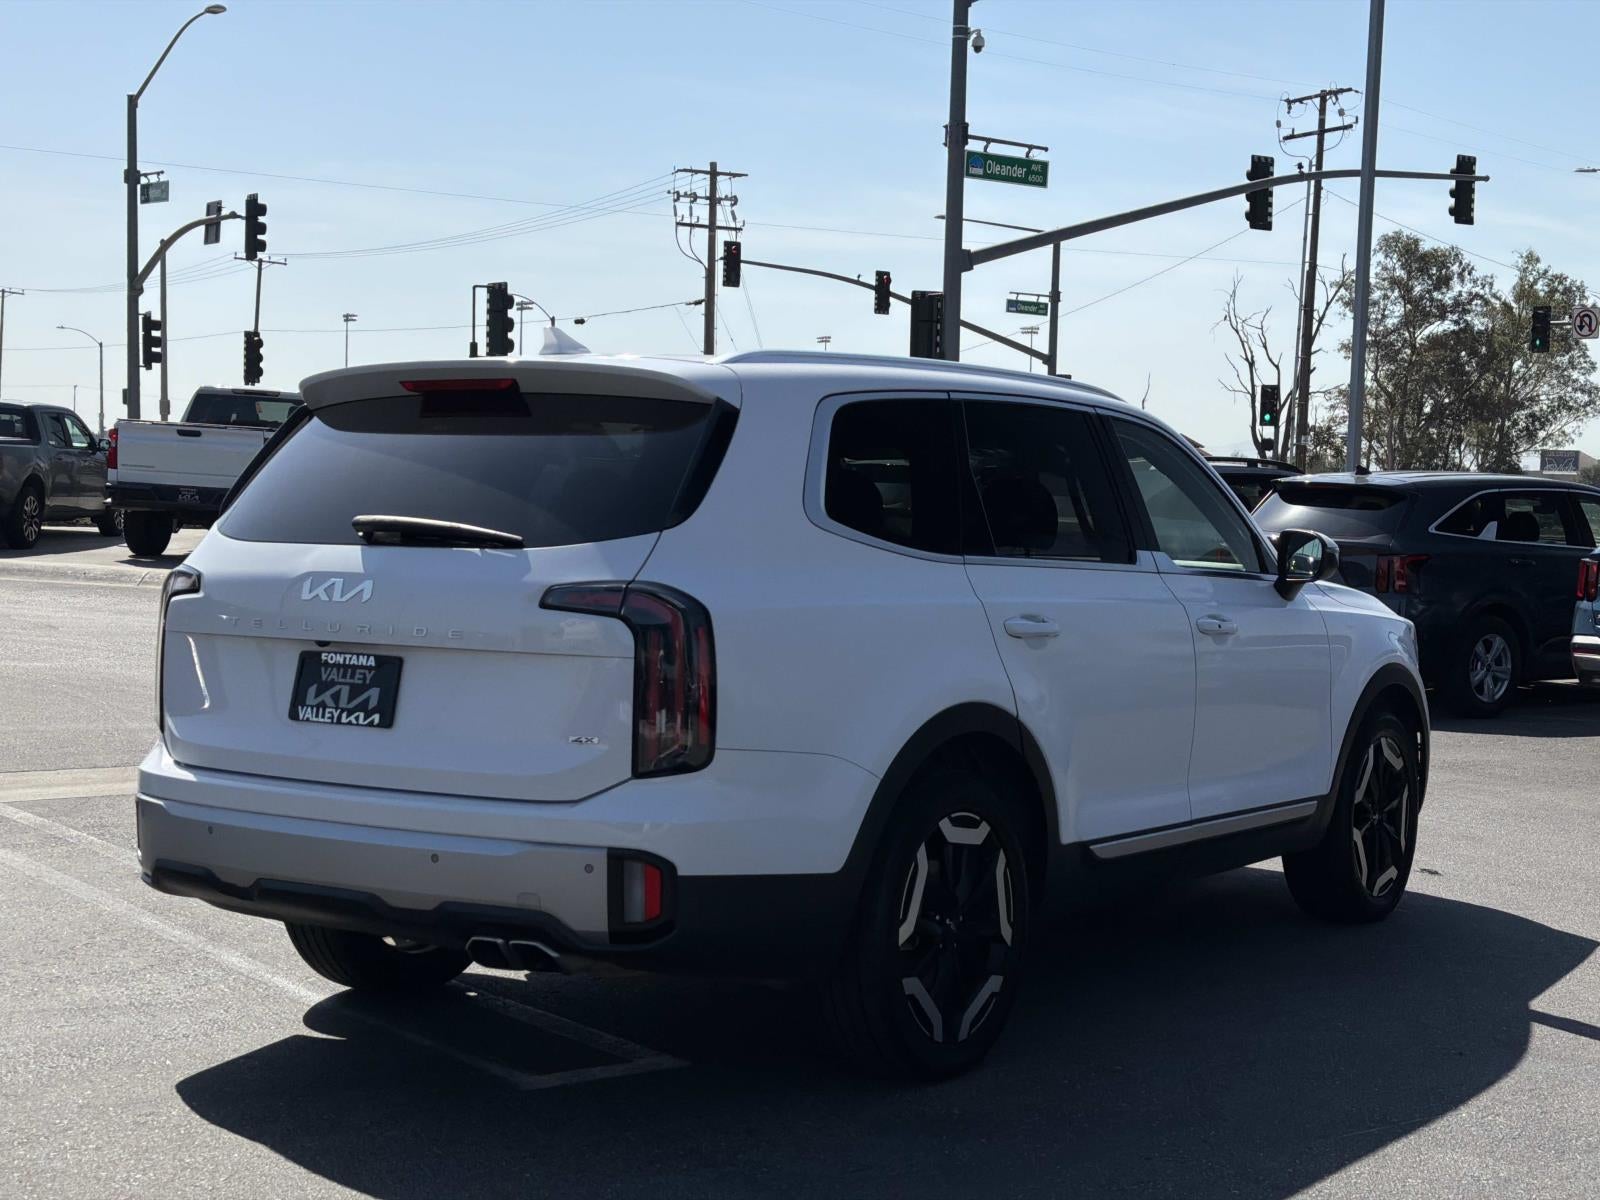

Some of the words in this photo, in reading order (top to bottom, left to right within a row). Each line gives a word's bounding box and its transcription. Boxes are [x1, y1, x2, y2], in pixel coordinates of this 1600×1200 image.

[986, 159, 1027, 178] Oleander
[1030, 163, 1042, 172] AVE
[1027, 174, 1043, 183] 6500
[301, 576, 374, 603] KIA
[229, 615, 465, 640] TELLURIDE
[321, 652, 376, 667] FONTANA
[321, 666, 376, 685] VALLEY
[306, 683, 381, 711] KIA
[298, 705, 341, 723] VALLEY
